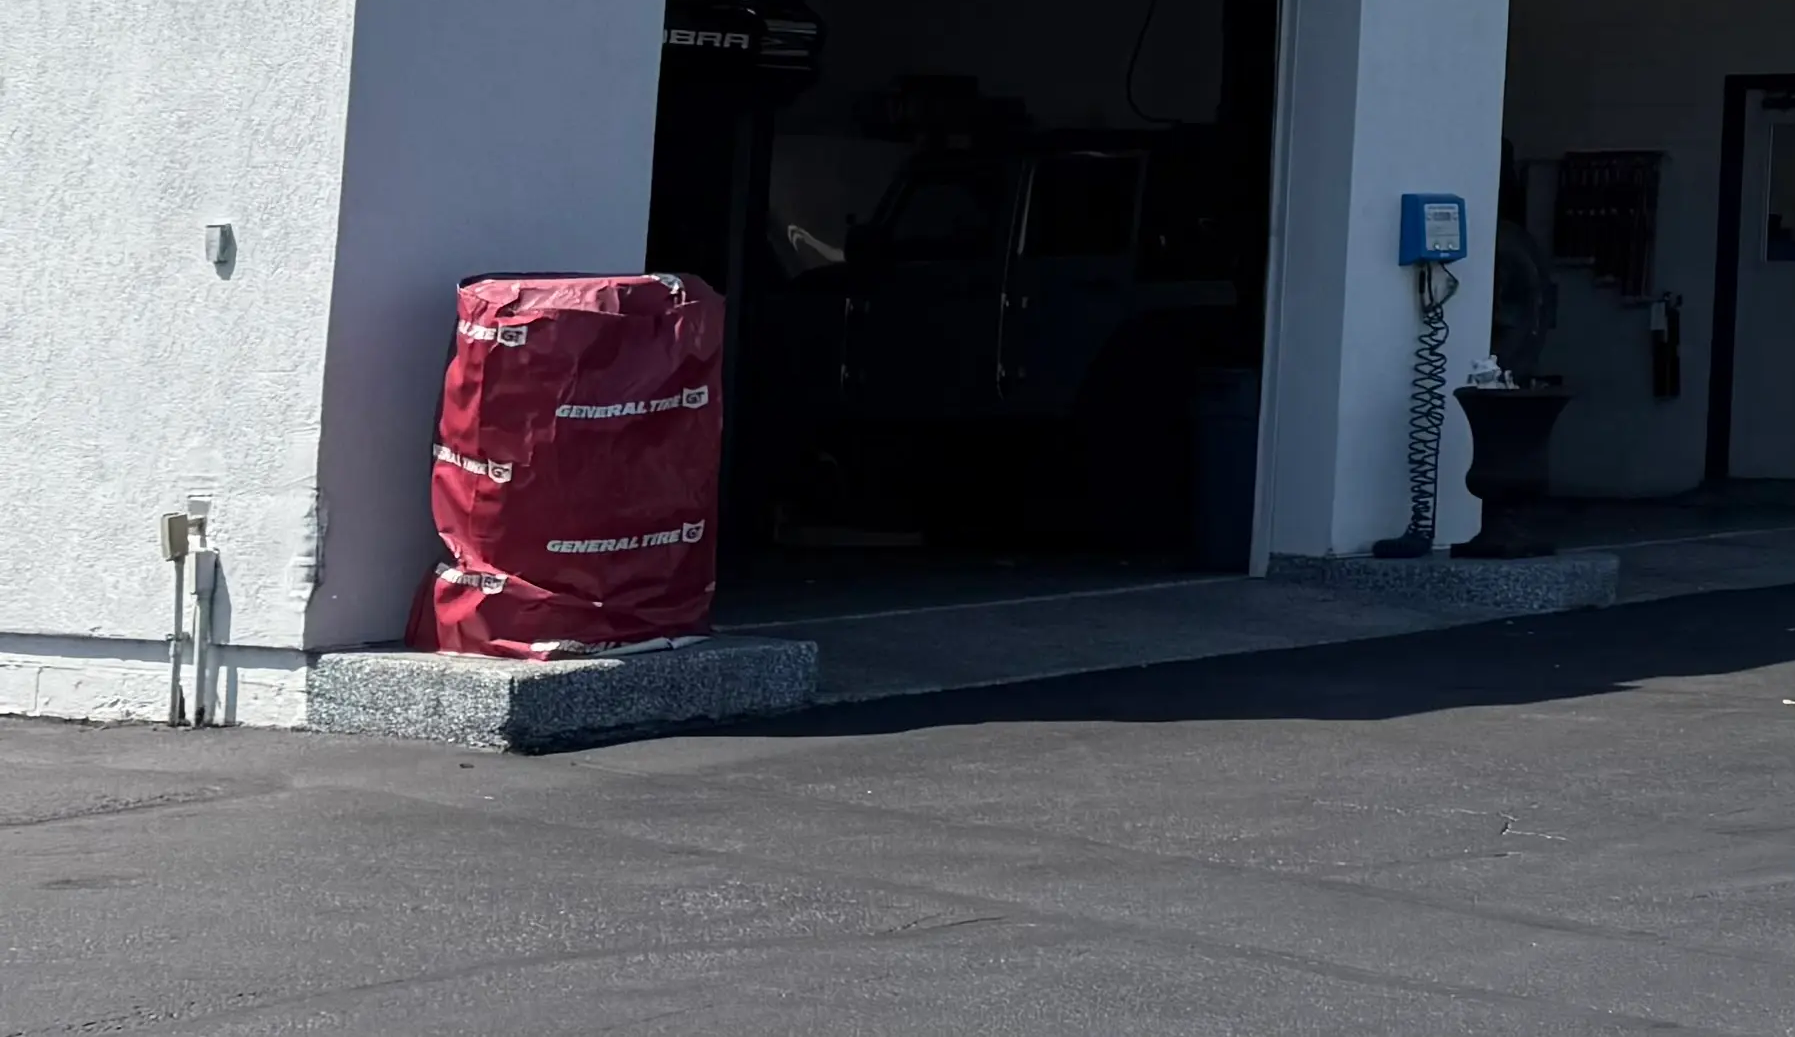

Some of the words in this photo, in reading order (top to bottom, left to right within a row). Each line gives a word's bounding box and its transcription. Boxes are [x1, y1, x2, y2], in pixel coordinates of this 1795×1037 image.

[663, 29, 749, 50] BRA
[555, 400, 647, 419] GENERAL
[648, 394, 682, 412] TIRE
[546, 535, 639, 554] GENERAL
[640, 529, 681, 547] TIRE
